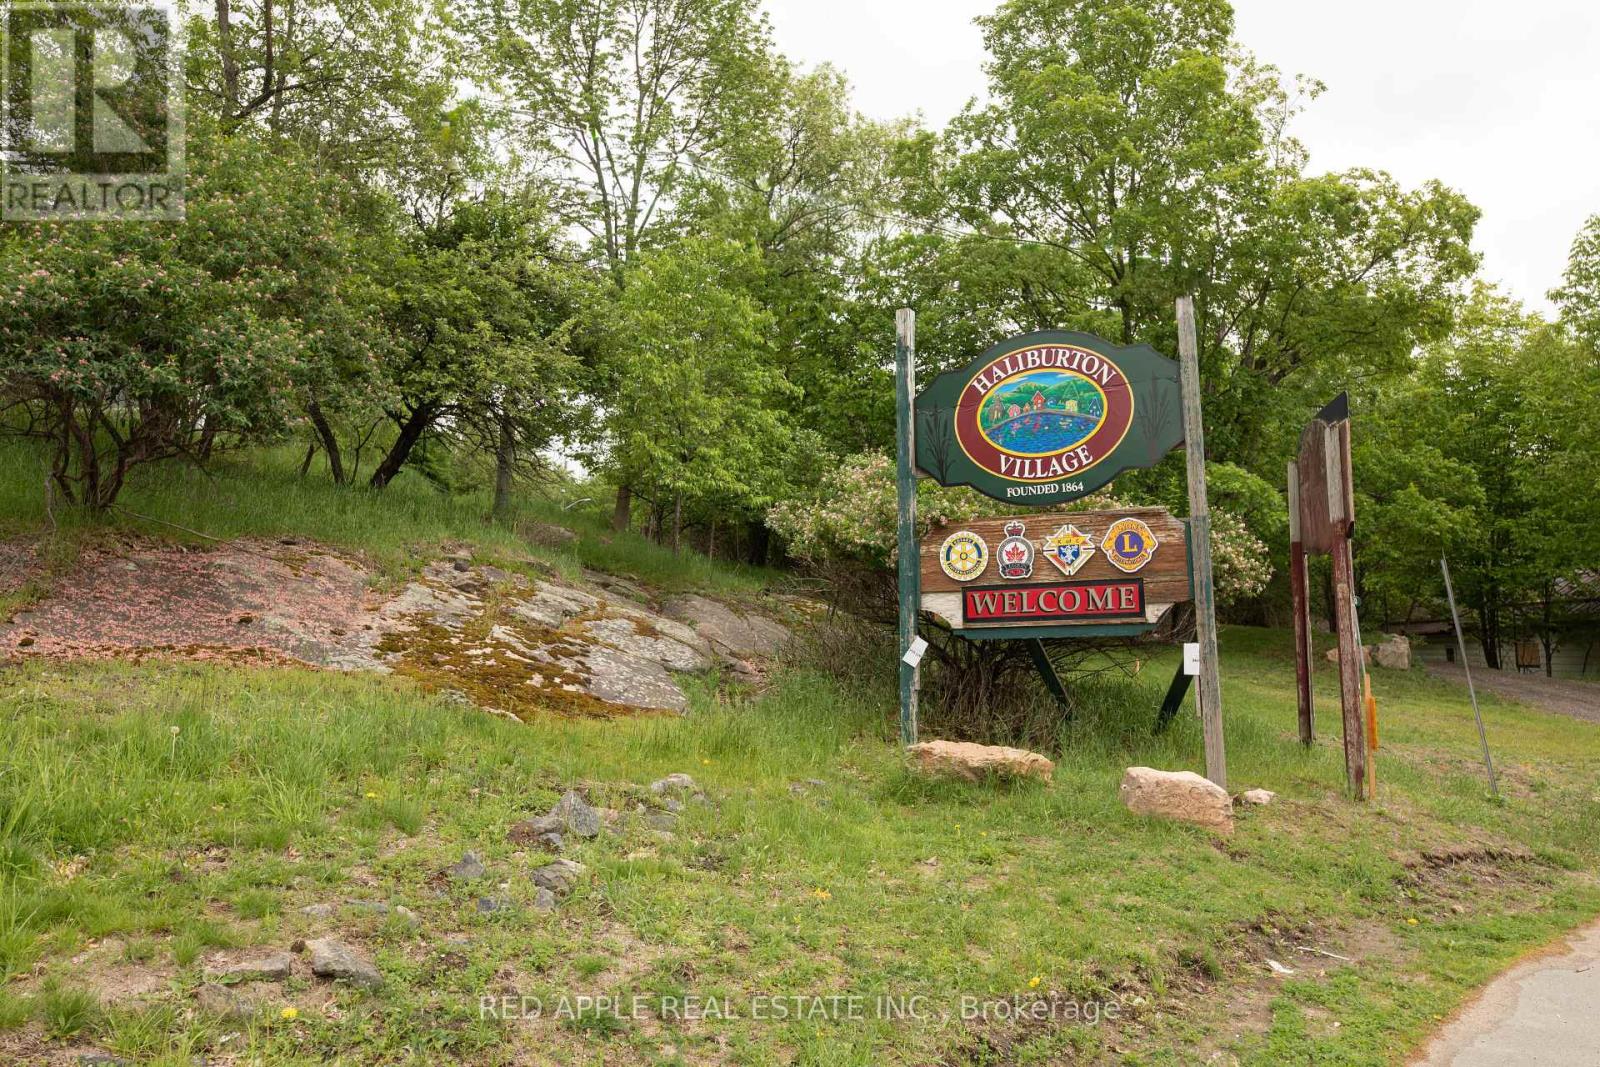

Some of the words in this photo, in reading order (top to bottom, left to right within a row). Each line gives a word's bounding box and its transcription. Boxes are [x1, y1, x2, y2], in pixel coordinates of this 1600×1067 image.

[971, 348, 1117, 395] HALIBURTON
[999, 444, 1094, 478] VILLAGE
[1006, 483, 1060, 498] FOUNDED
[1061, 481, 1084, 493] 1864
[1122, 534, 1138, 553] L
[971, 586, 1137, 615] WELCOME
